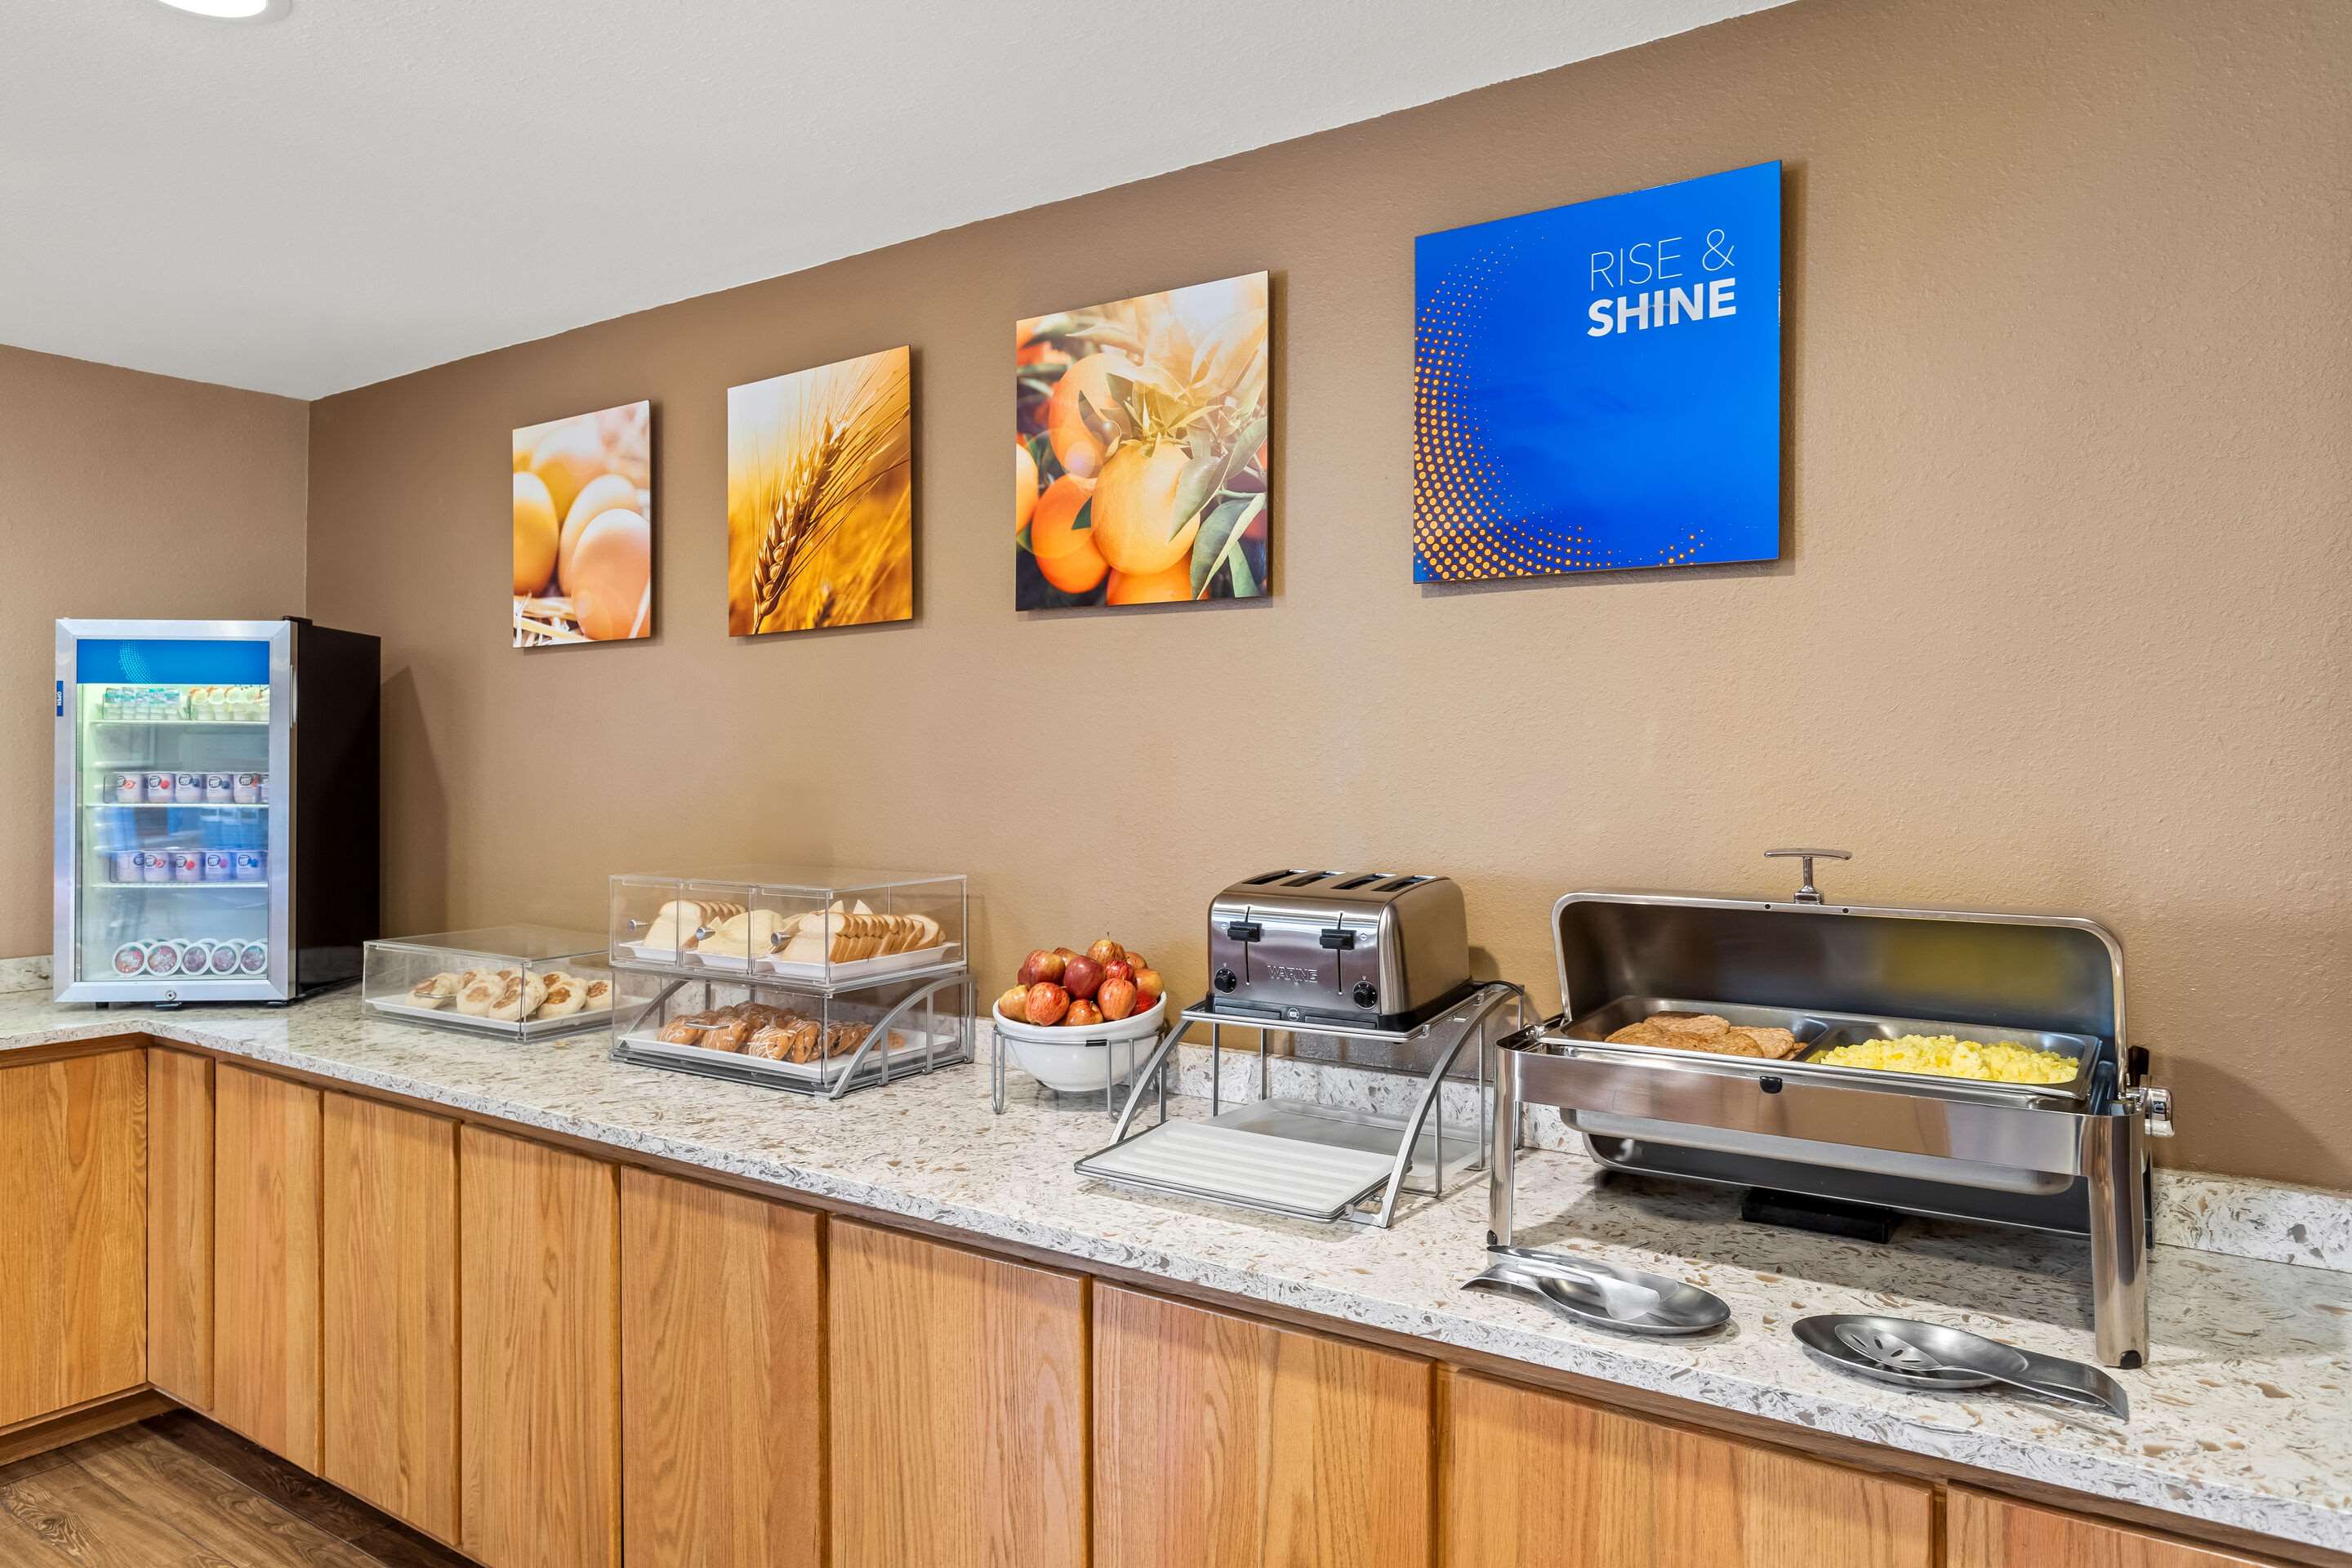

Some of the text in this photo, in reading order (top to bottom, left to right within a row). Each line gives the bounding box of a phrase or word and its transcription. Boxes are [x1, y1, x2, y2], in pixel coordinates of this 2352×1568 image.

[1591, 229, 1735, 292] RISE &
[1587, 277, 1737, 337] SHINE
